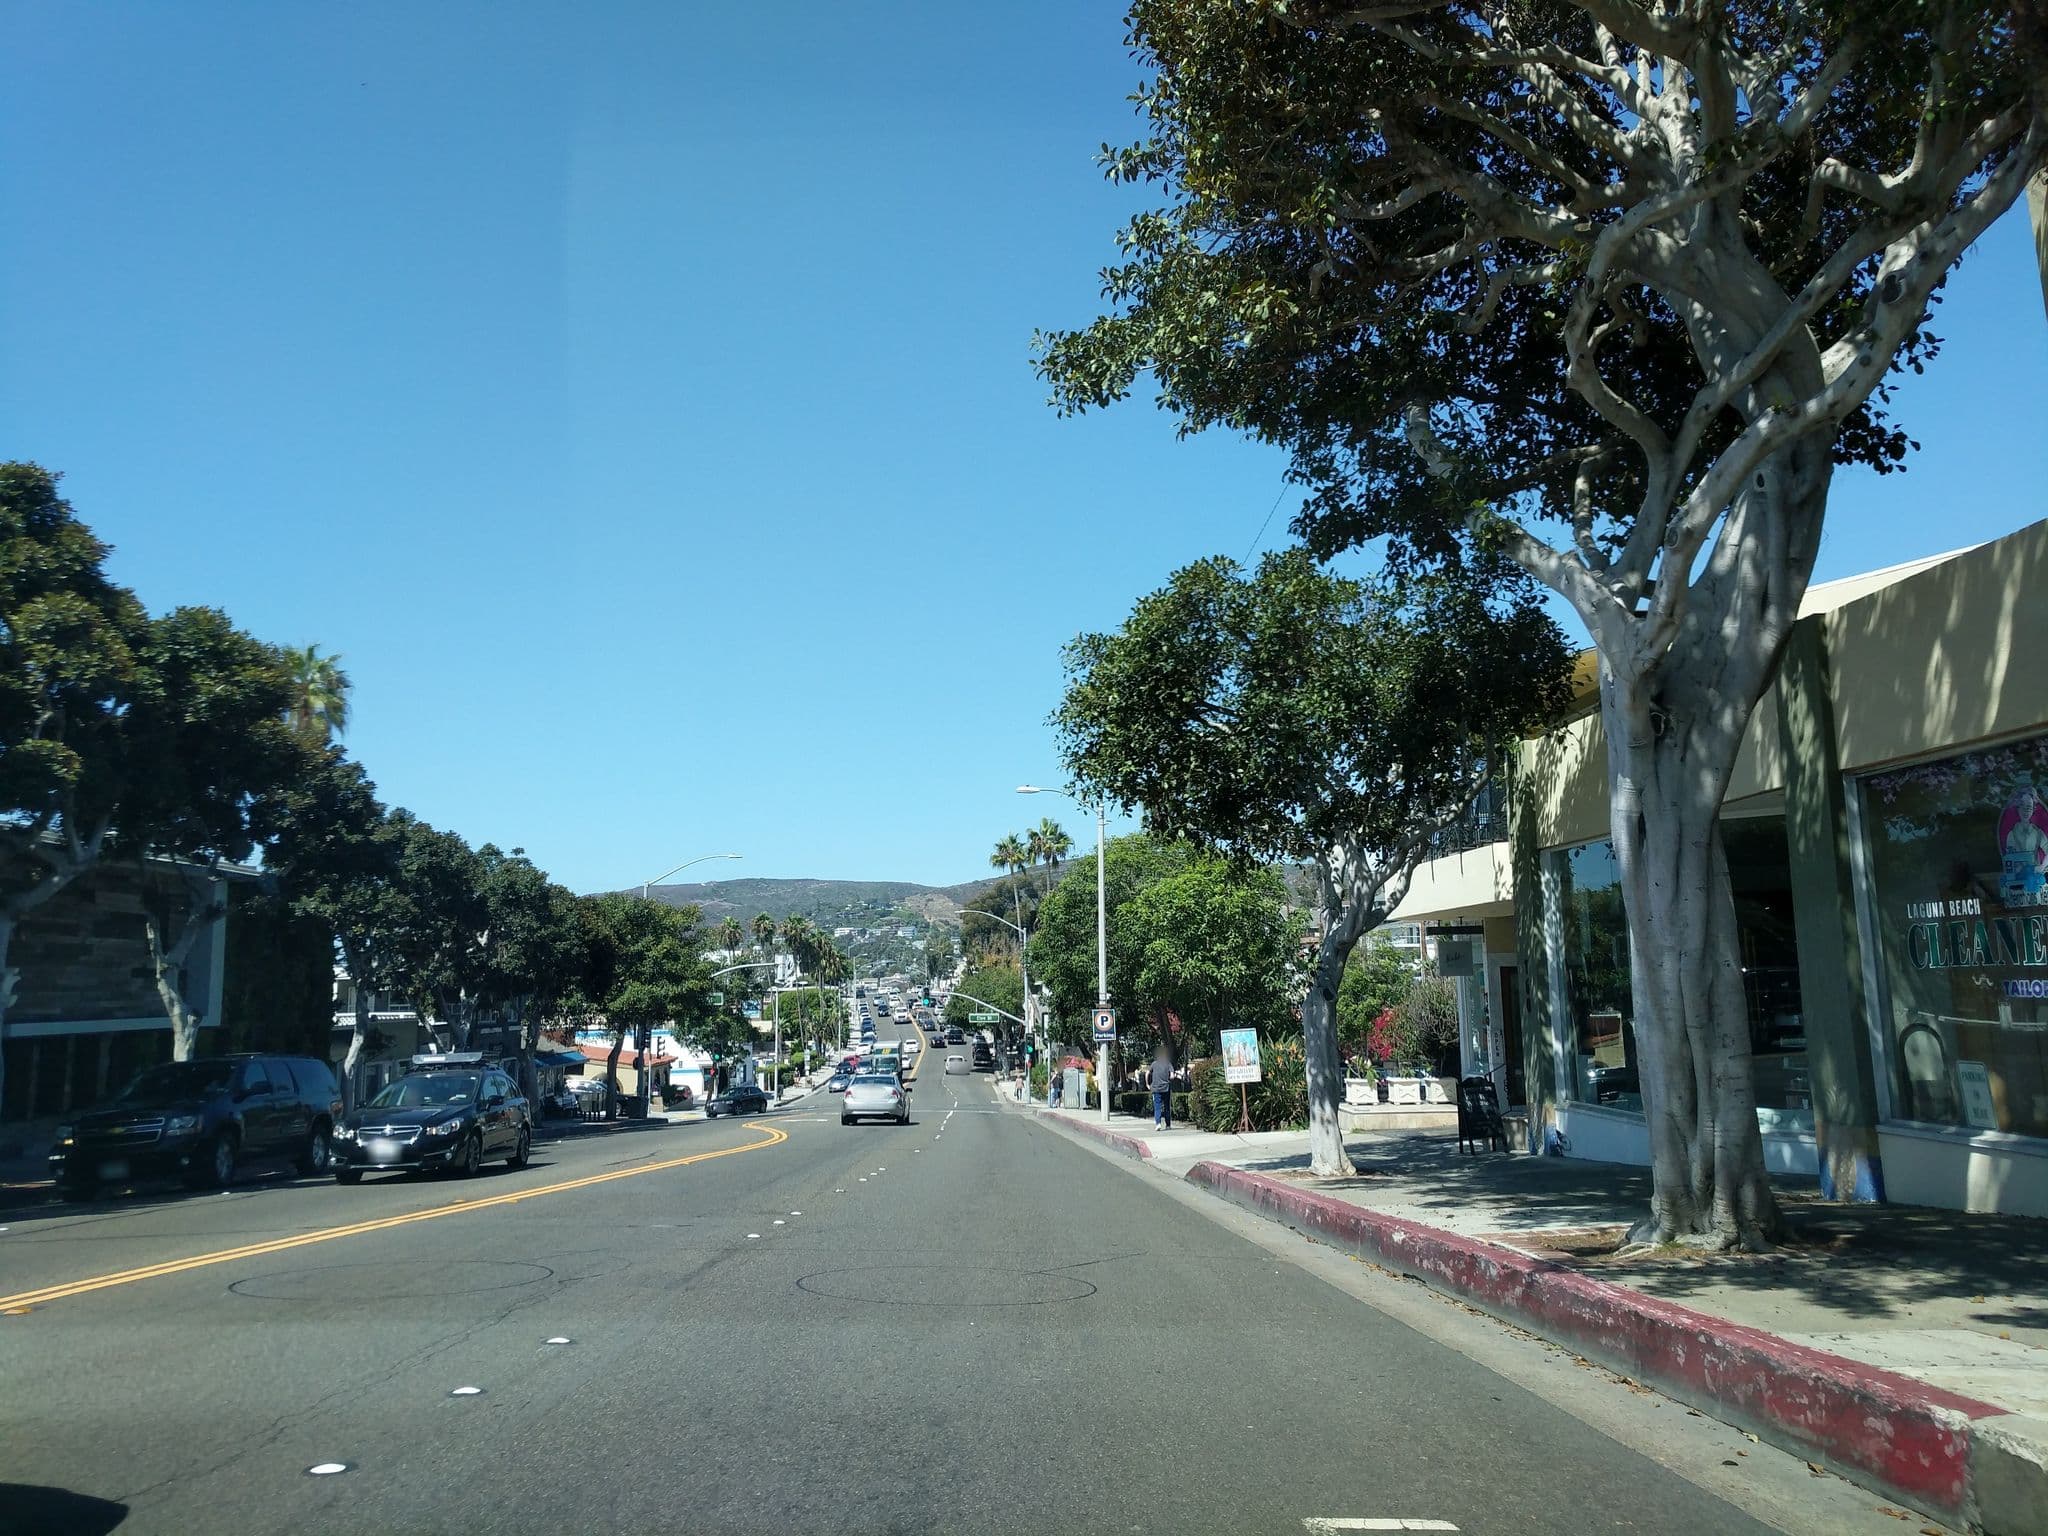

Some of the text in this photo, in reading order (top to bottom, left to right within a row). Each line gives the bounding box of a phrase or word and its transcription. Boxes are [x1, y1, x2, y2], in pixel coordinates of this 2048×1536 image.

[1907, 898, 1981, 919] LAGUNA BEACH
[1908, 914, 2048, 970] CLEANE
[1100, 1015, 1109, 1026] P
